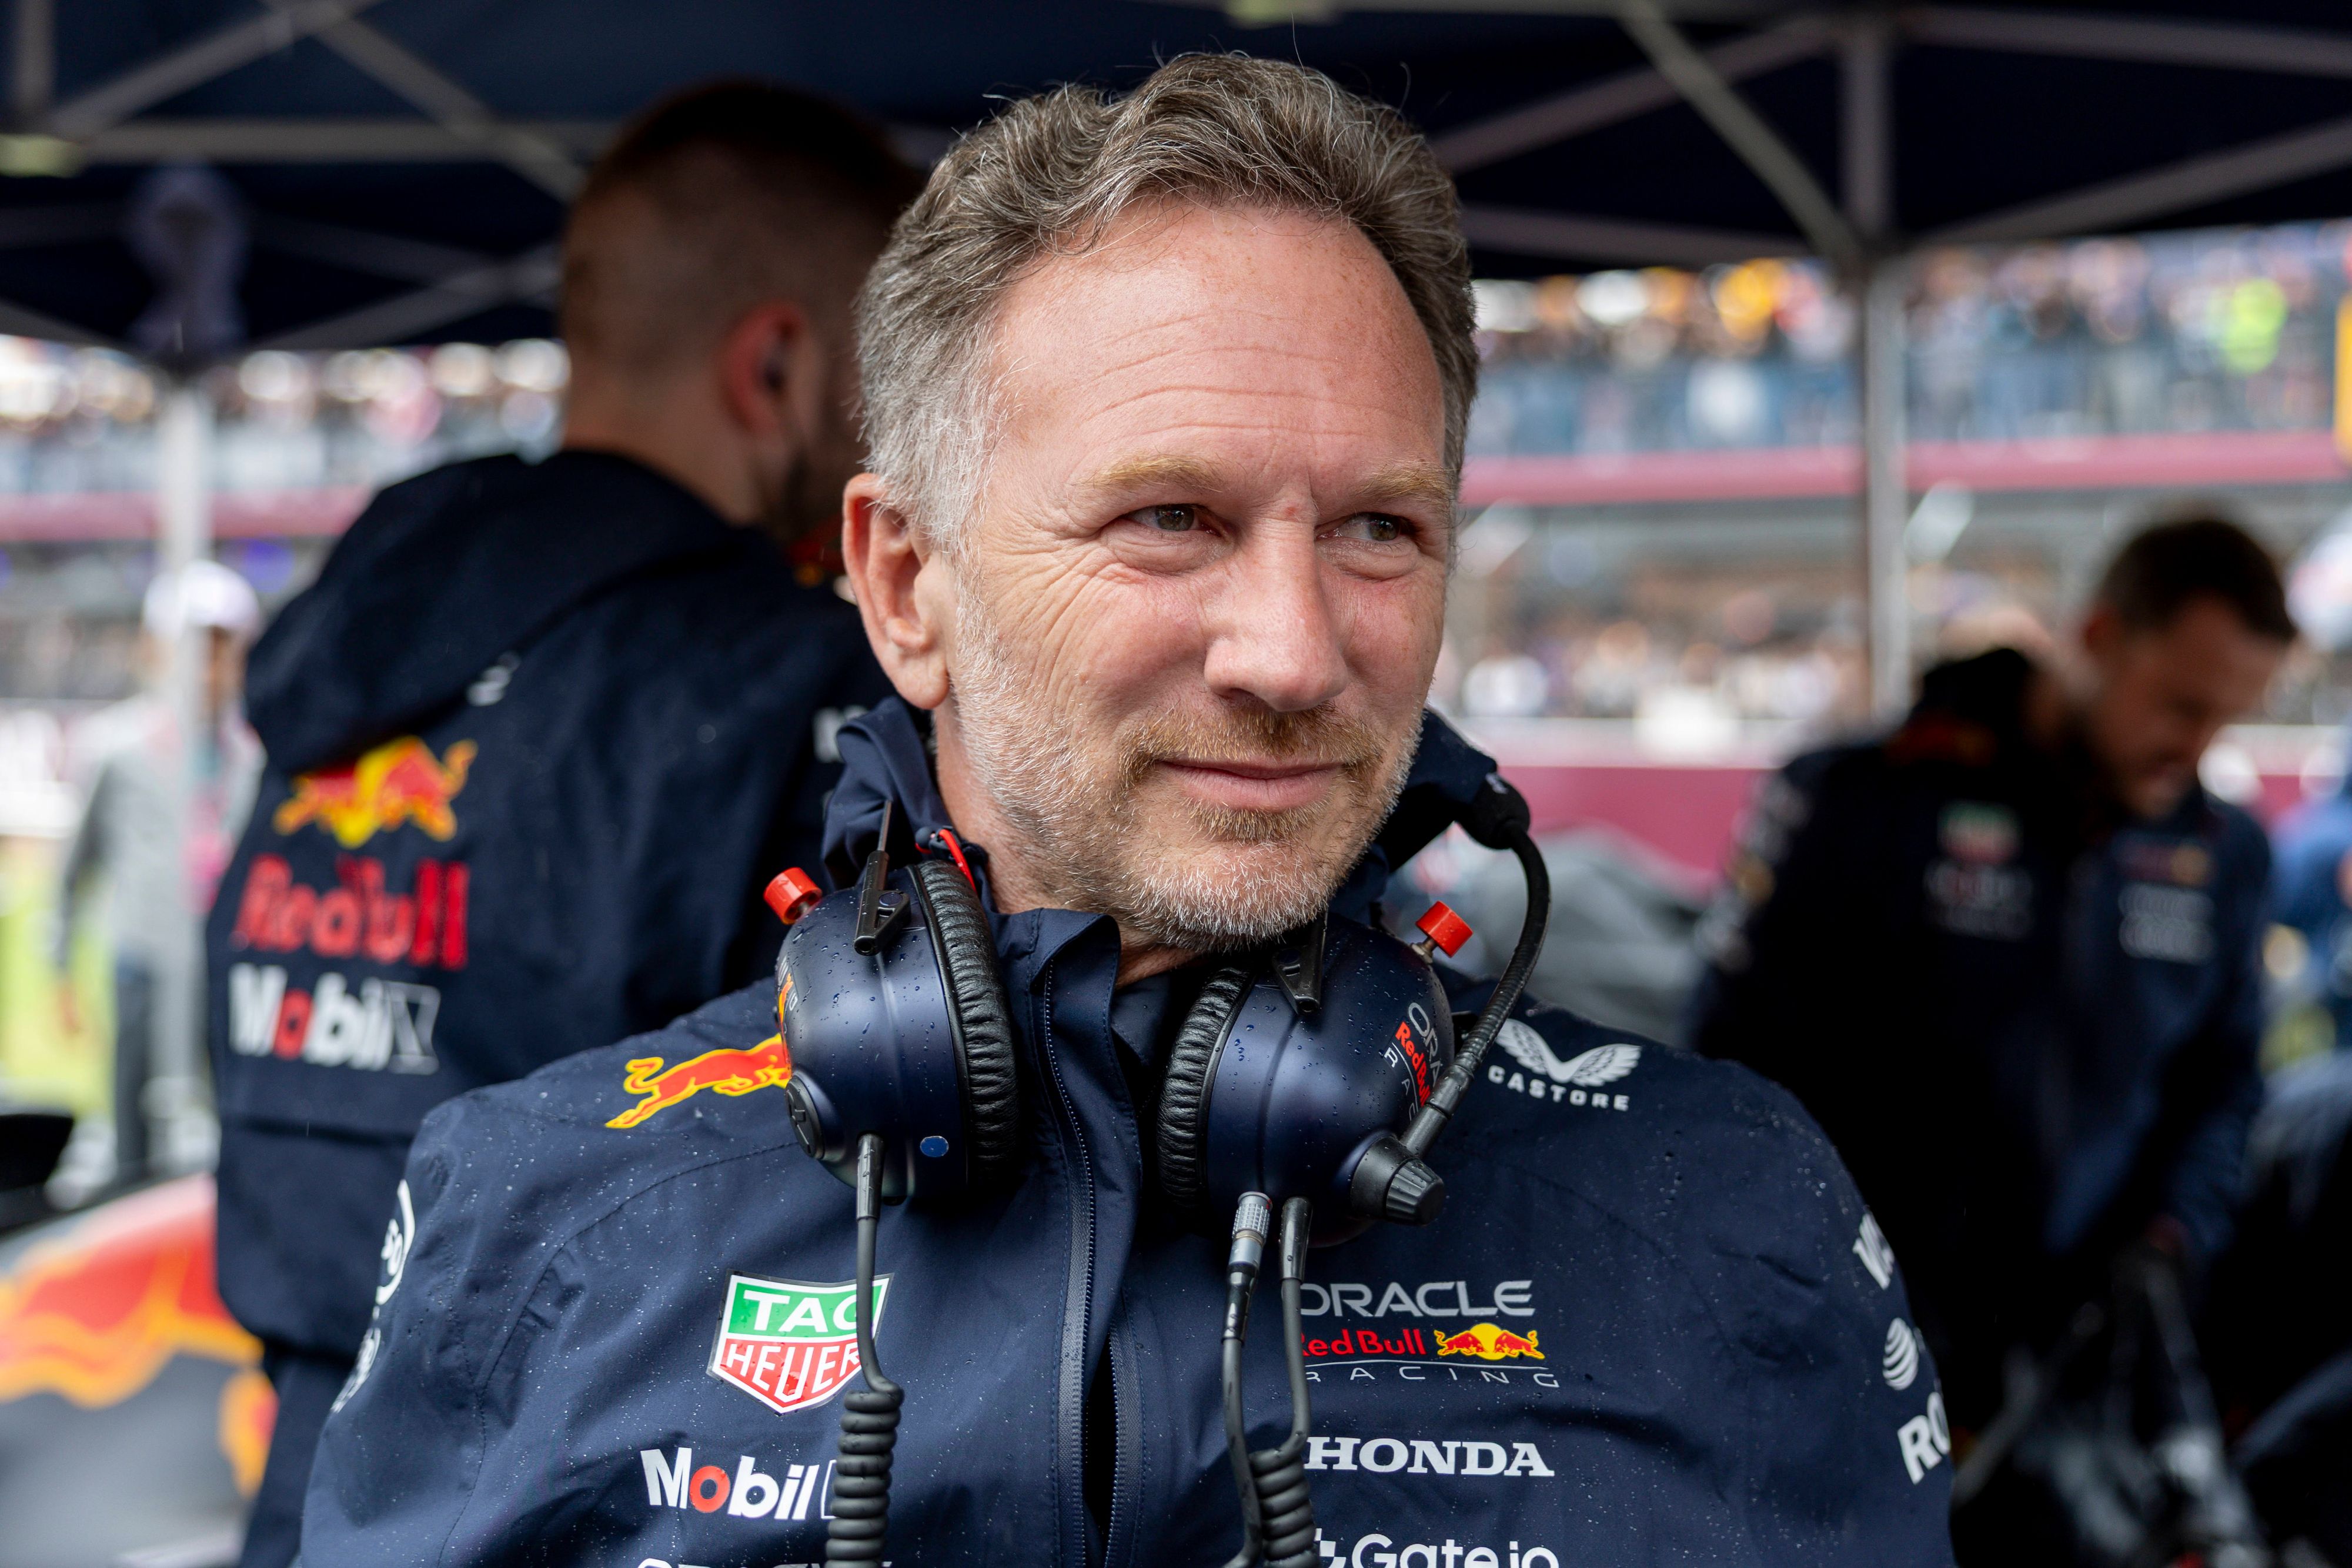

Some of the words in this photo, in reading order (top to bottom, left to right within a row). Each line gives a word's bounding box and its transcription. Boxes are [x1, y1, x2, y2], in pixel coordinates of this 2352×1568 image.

[1488, 1065, 1630, 1111] CASTORE
[1282, 1279, 1536, 1318] ORACLE
[726, 1342, 860, 1403] HEUER
[1304, 1436, 1555, 1477] HONDA
[640, 1447, 820, 1521] Mobil
